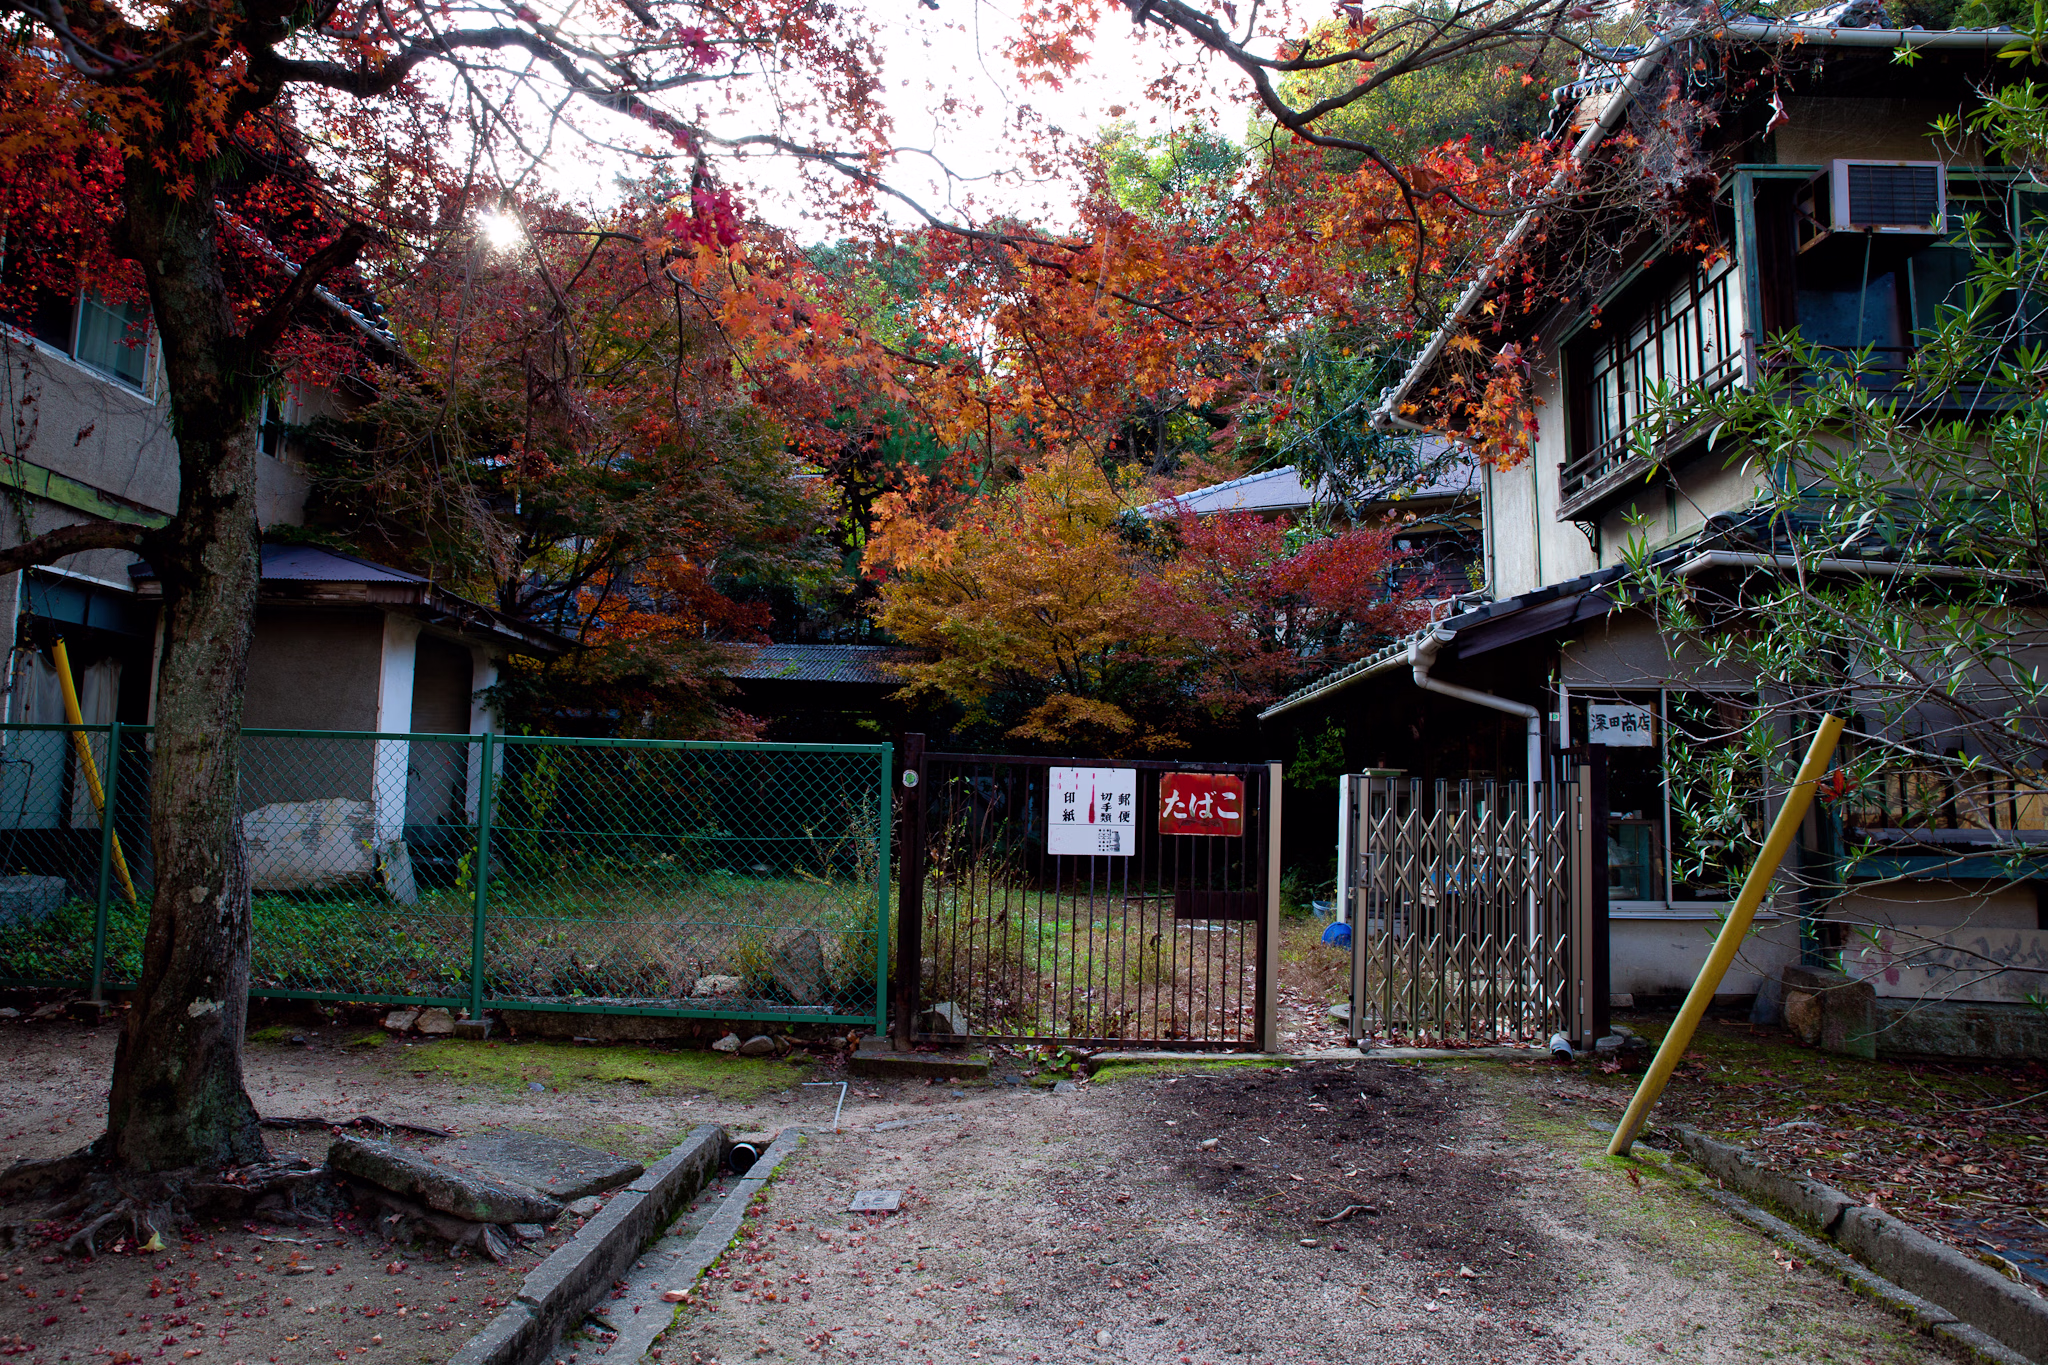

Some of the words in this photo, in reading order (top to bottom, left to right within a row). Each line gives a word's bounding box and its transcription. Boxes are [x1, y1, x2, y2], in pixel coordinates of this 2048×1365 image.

[1591, 712, 1650, 732] 深田商店
[1062, 791, 1075, 822] 印紙
[1100, 792, 1113, 823] 切手類
[1118, 793, 1131, 823] 郵便
[1162, 789, 1240, 820] たばこ
